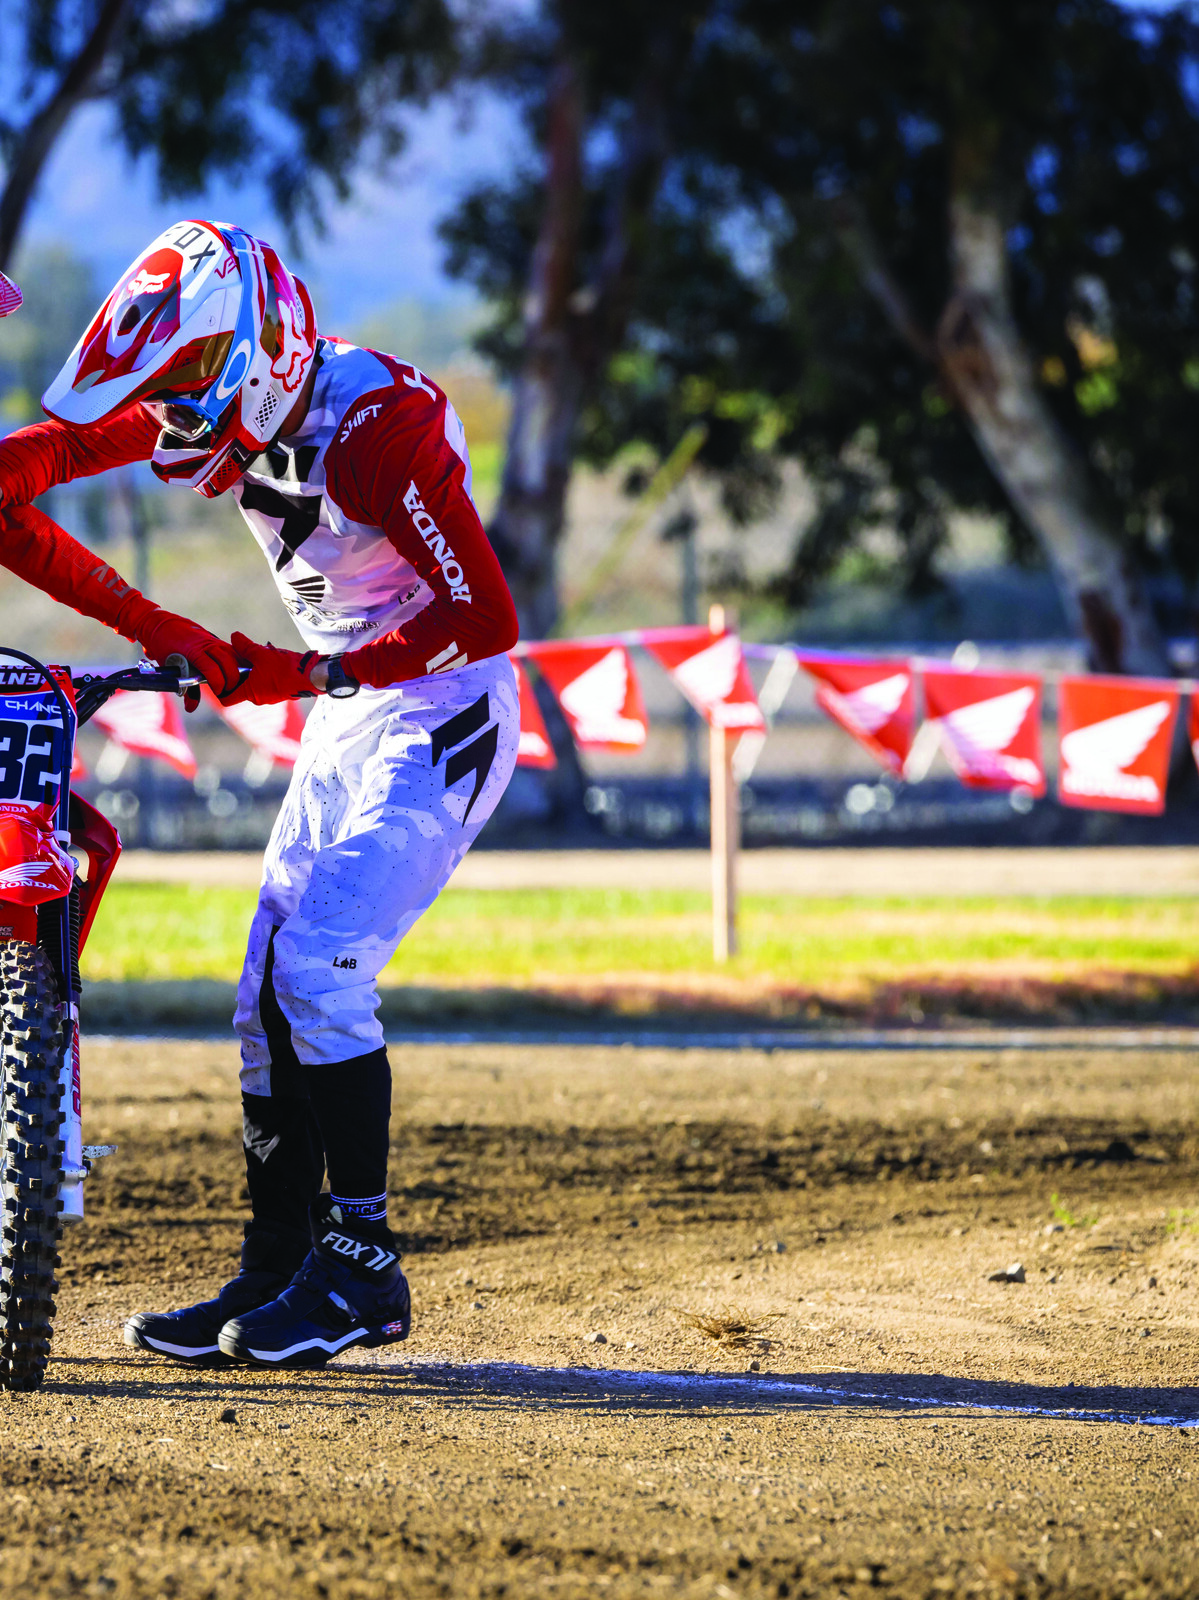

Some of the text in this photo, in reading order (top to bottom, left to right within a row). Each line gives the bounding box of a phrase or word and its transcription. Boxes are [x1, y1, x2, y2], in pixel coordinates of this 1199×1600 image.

[340, 403, 383, 444] SHIFT
[402, 480, 472, 604] HONDA
[4, 700, 72, 717] CHANC
[321, 1231, 371, 1260] FOX
